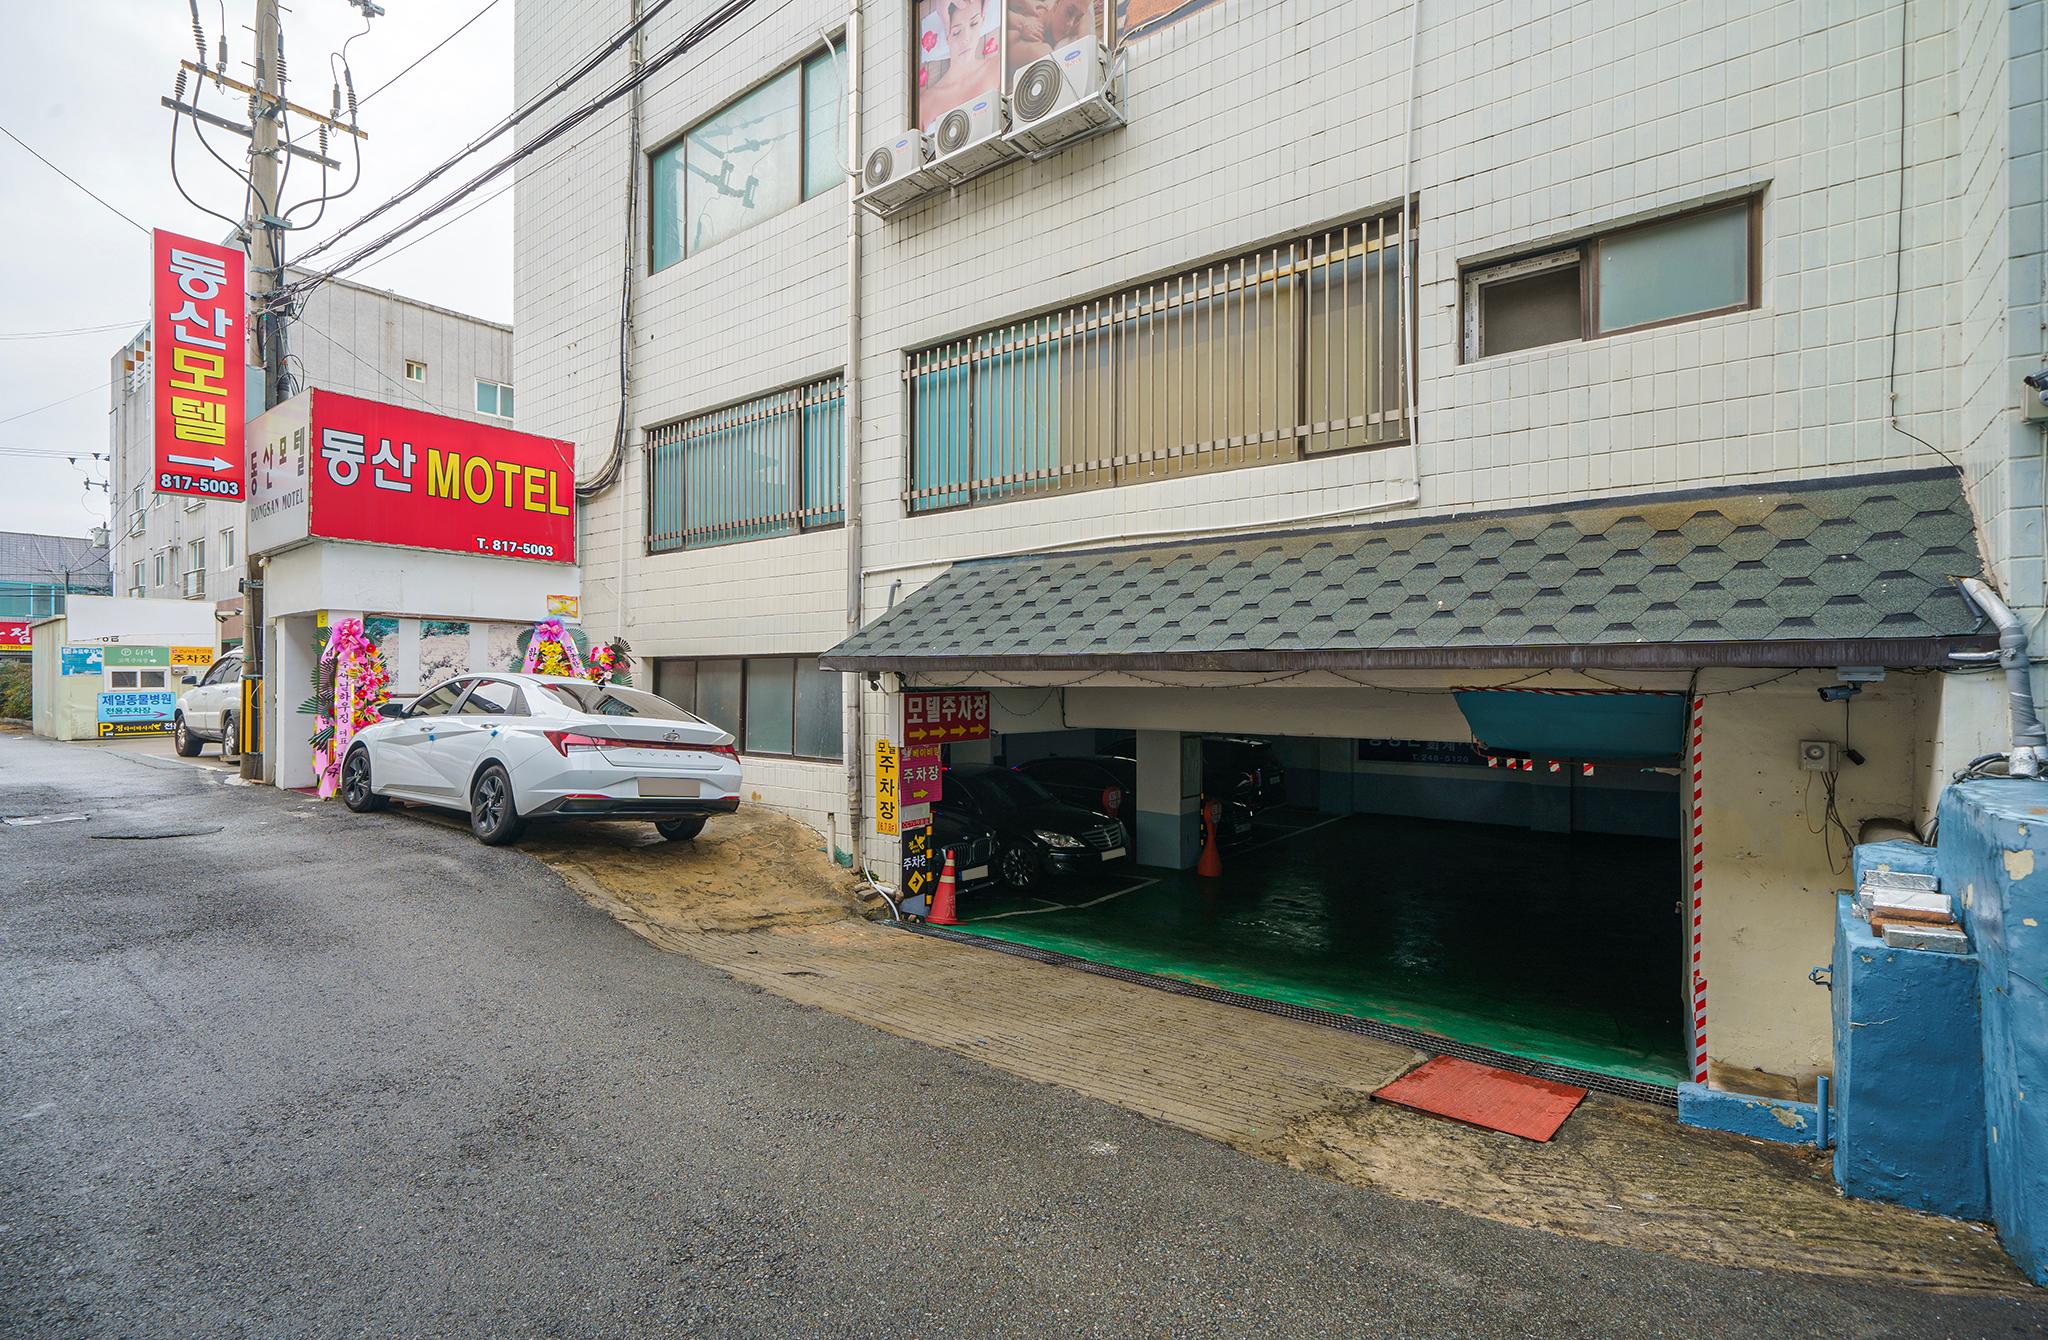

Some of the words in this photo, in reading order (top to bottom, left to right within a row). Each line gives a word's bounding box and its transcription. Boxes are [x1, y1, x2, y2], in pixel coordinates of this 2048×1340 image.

[169, 248, 233, 446] 동산모텔
[320, 427, 417, 493] 동산
[427, 447, 571, 516] MOTEL
[160, 473, 240, 495] 817-5003
[251, 498, 279, 522] DONGSAN
[282, 488, 304, 510] MOTEL
[492, 539, 554, 557] 817-5003
[172, 654, 211, 664] 주차장
[102, 693, 172, 706] 제일동물병원
[907, 695, 987, 724] 모텔주차장
[105, 707, 151, 715] 전용주차장
[100, 722, 114, 737] P
[903, 765, 939, 784] 주차장
[879, 755, 895, 820] 주차장
